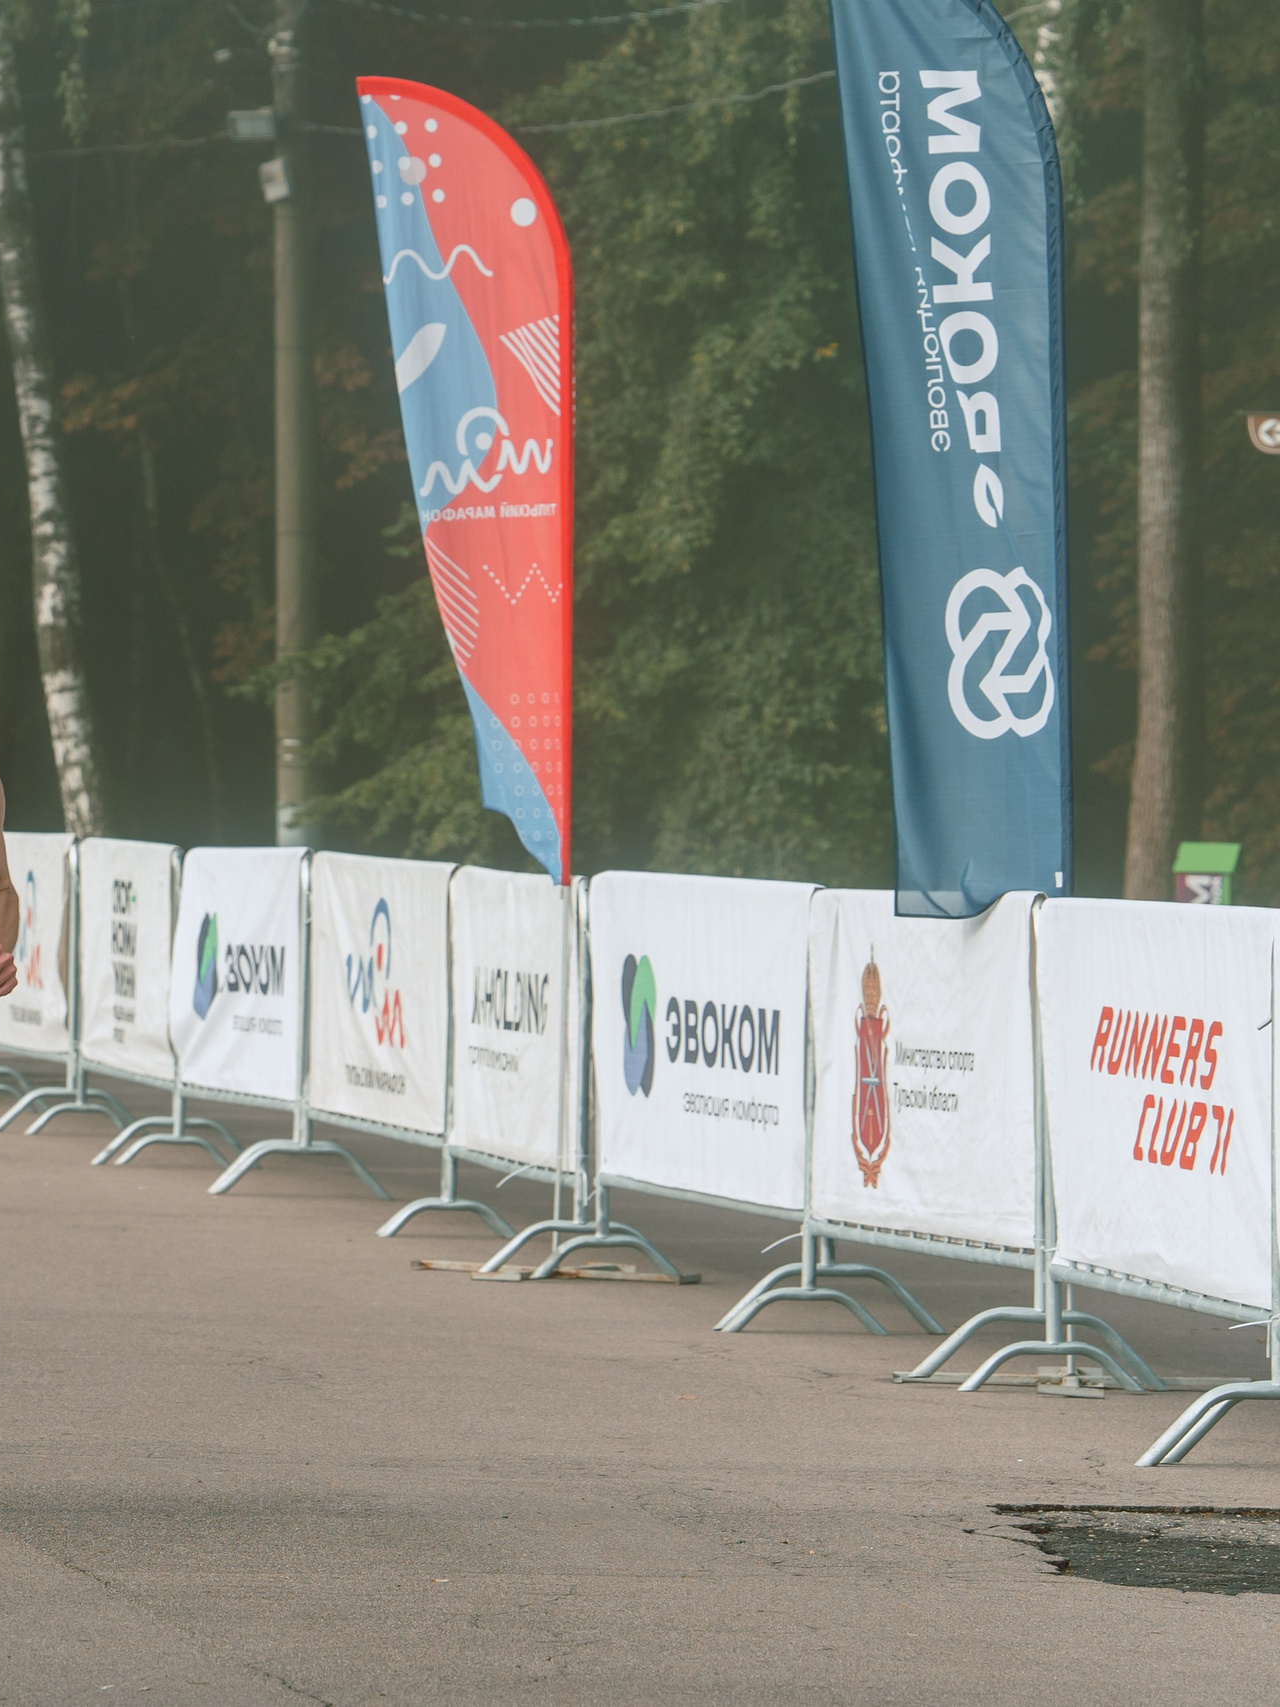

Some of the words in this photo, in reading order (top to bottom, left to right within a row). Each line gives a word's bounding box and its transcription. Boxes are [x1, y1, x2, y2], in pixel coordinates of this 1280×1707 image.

[665, 996, 781, 1075] ЭВОКОМ
[948, 1051, 975, 1077] спорта
[1089, 1005, 1223, 1091] RUNNERS
[1133, 1094, 1208, 1171] CLUB
[1209, 1104, 1235, 1177] 71
